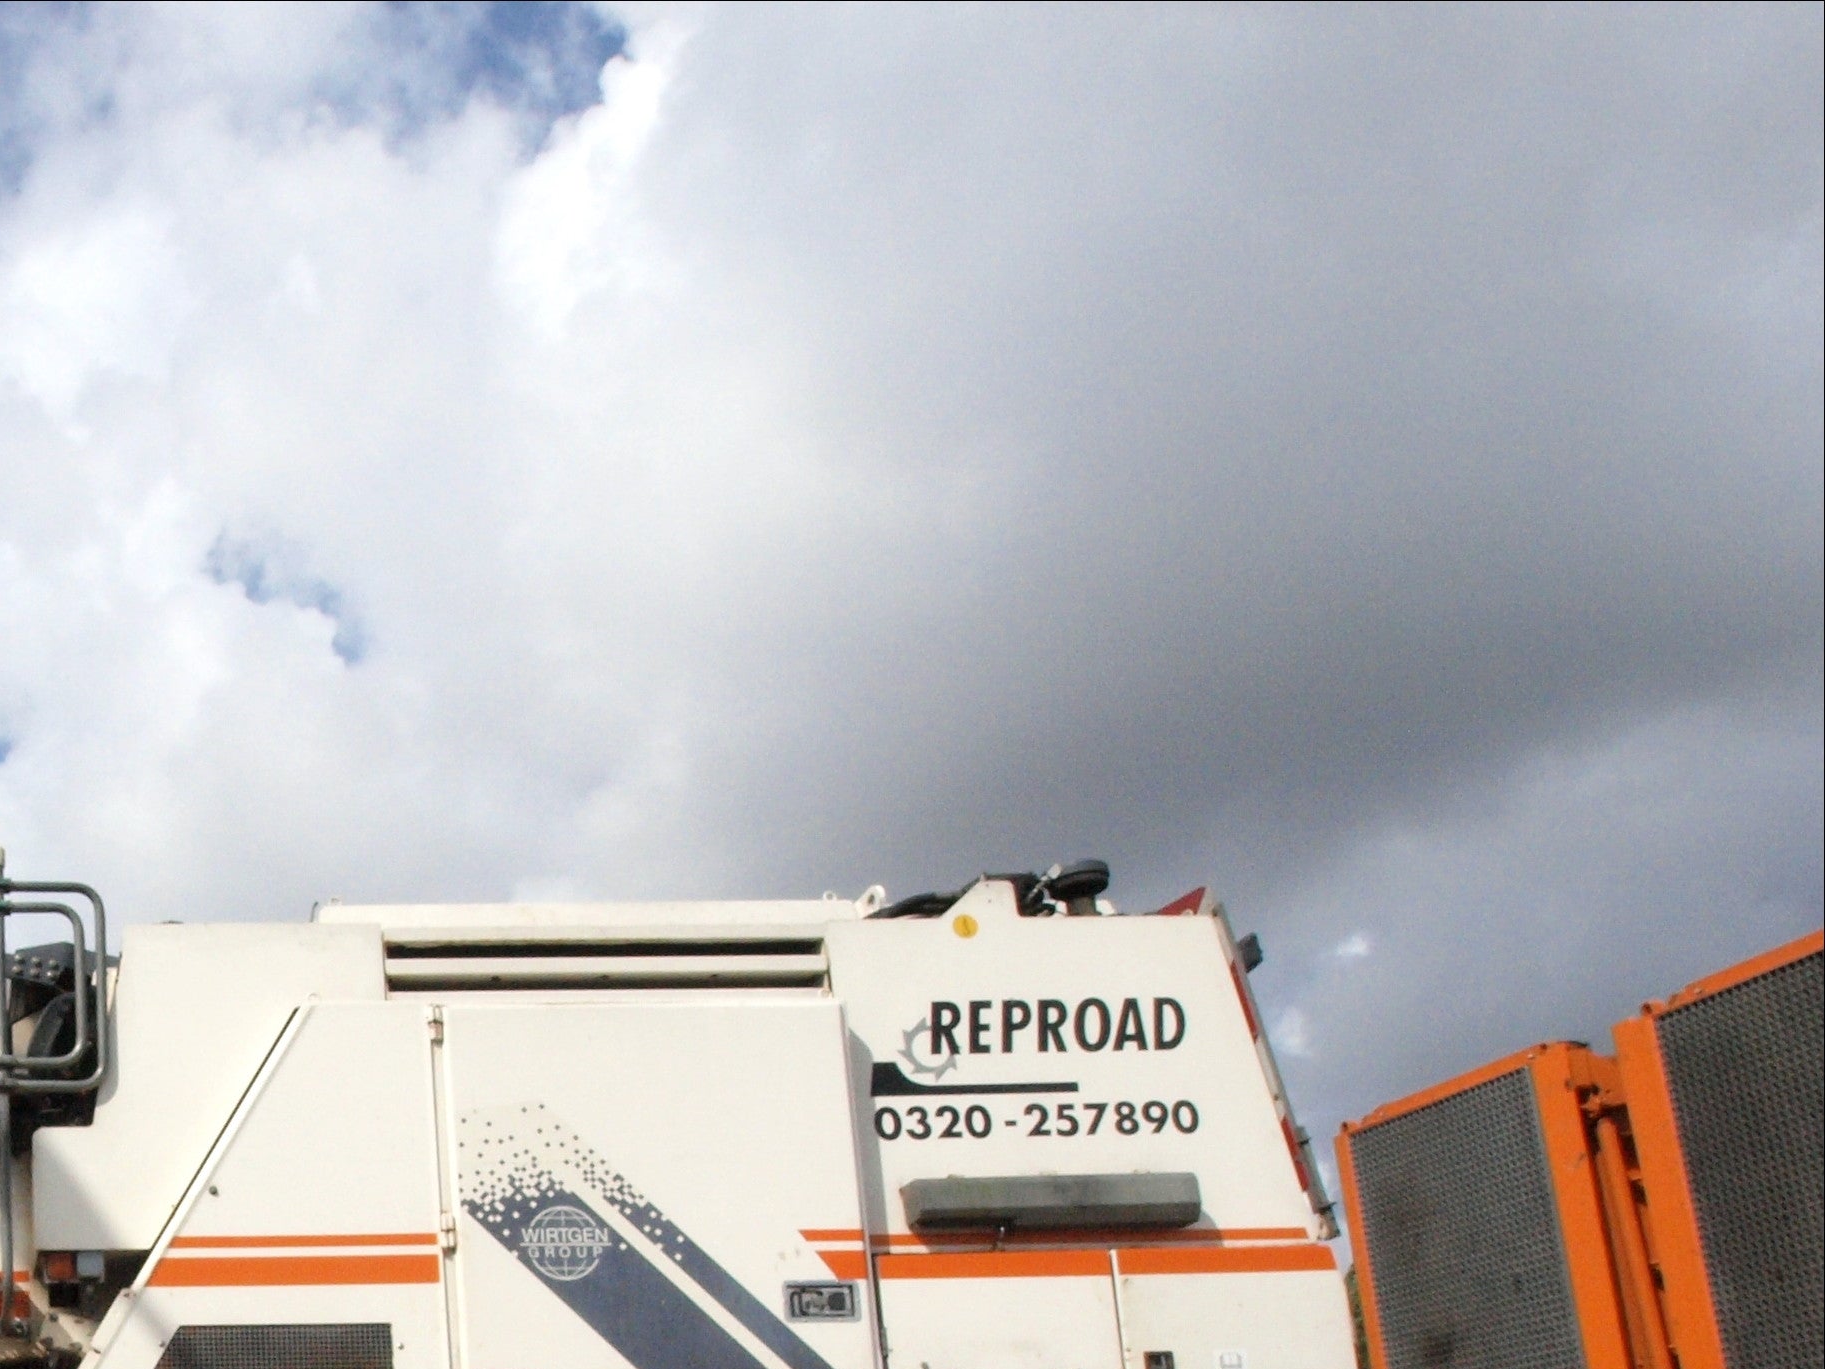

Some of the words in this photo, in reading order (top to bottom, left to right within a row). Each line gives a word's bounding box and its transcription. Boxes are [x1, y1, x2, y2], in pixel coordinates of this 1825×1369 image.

[929, 997, 1186, 1056] REPROAD
[521, 1227, 608, 1243] WIRTGEN
[528, 1245, 603, 1259] GROUP
